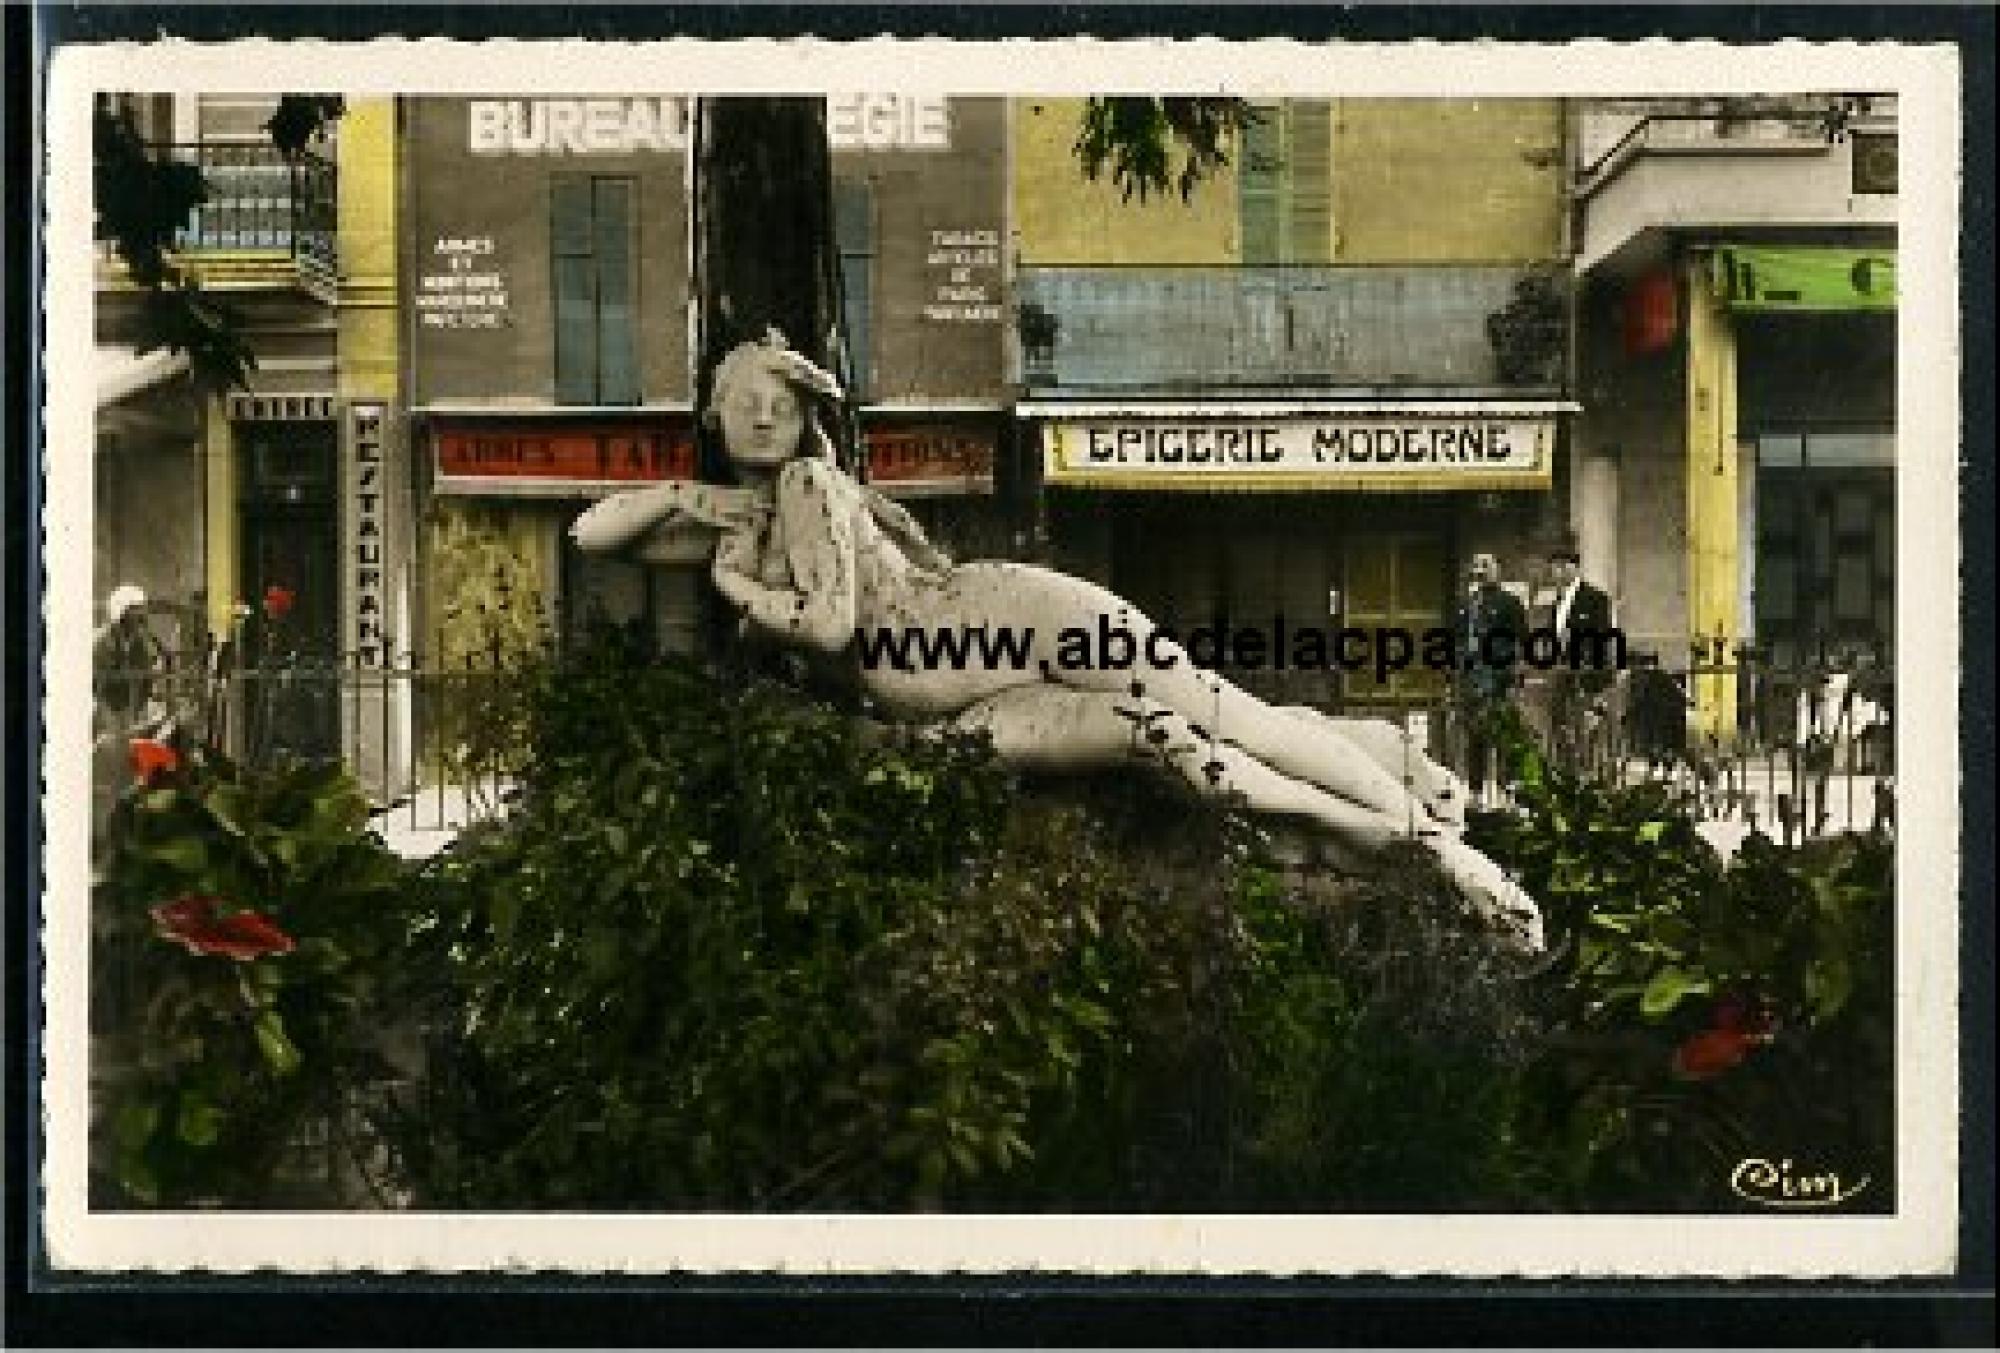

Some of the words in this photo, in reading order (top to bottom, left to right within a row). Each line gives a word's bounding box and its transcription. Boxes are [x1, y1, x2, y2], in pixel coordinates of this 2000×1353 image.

[470, 99, 690, 152] BUREAU
[829, 96, 950, 149] EGIE
[1089, 428, 1284, 464] EPICERIE
[1312, 428, 1512, 464] MODERNE
[356, 414, 380, 668] RESTAURANT
